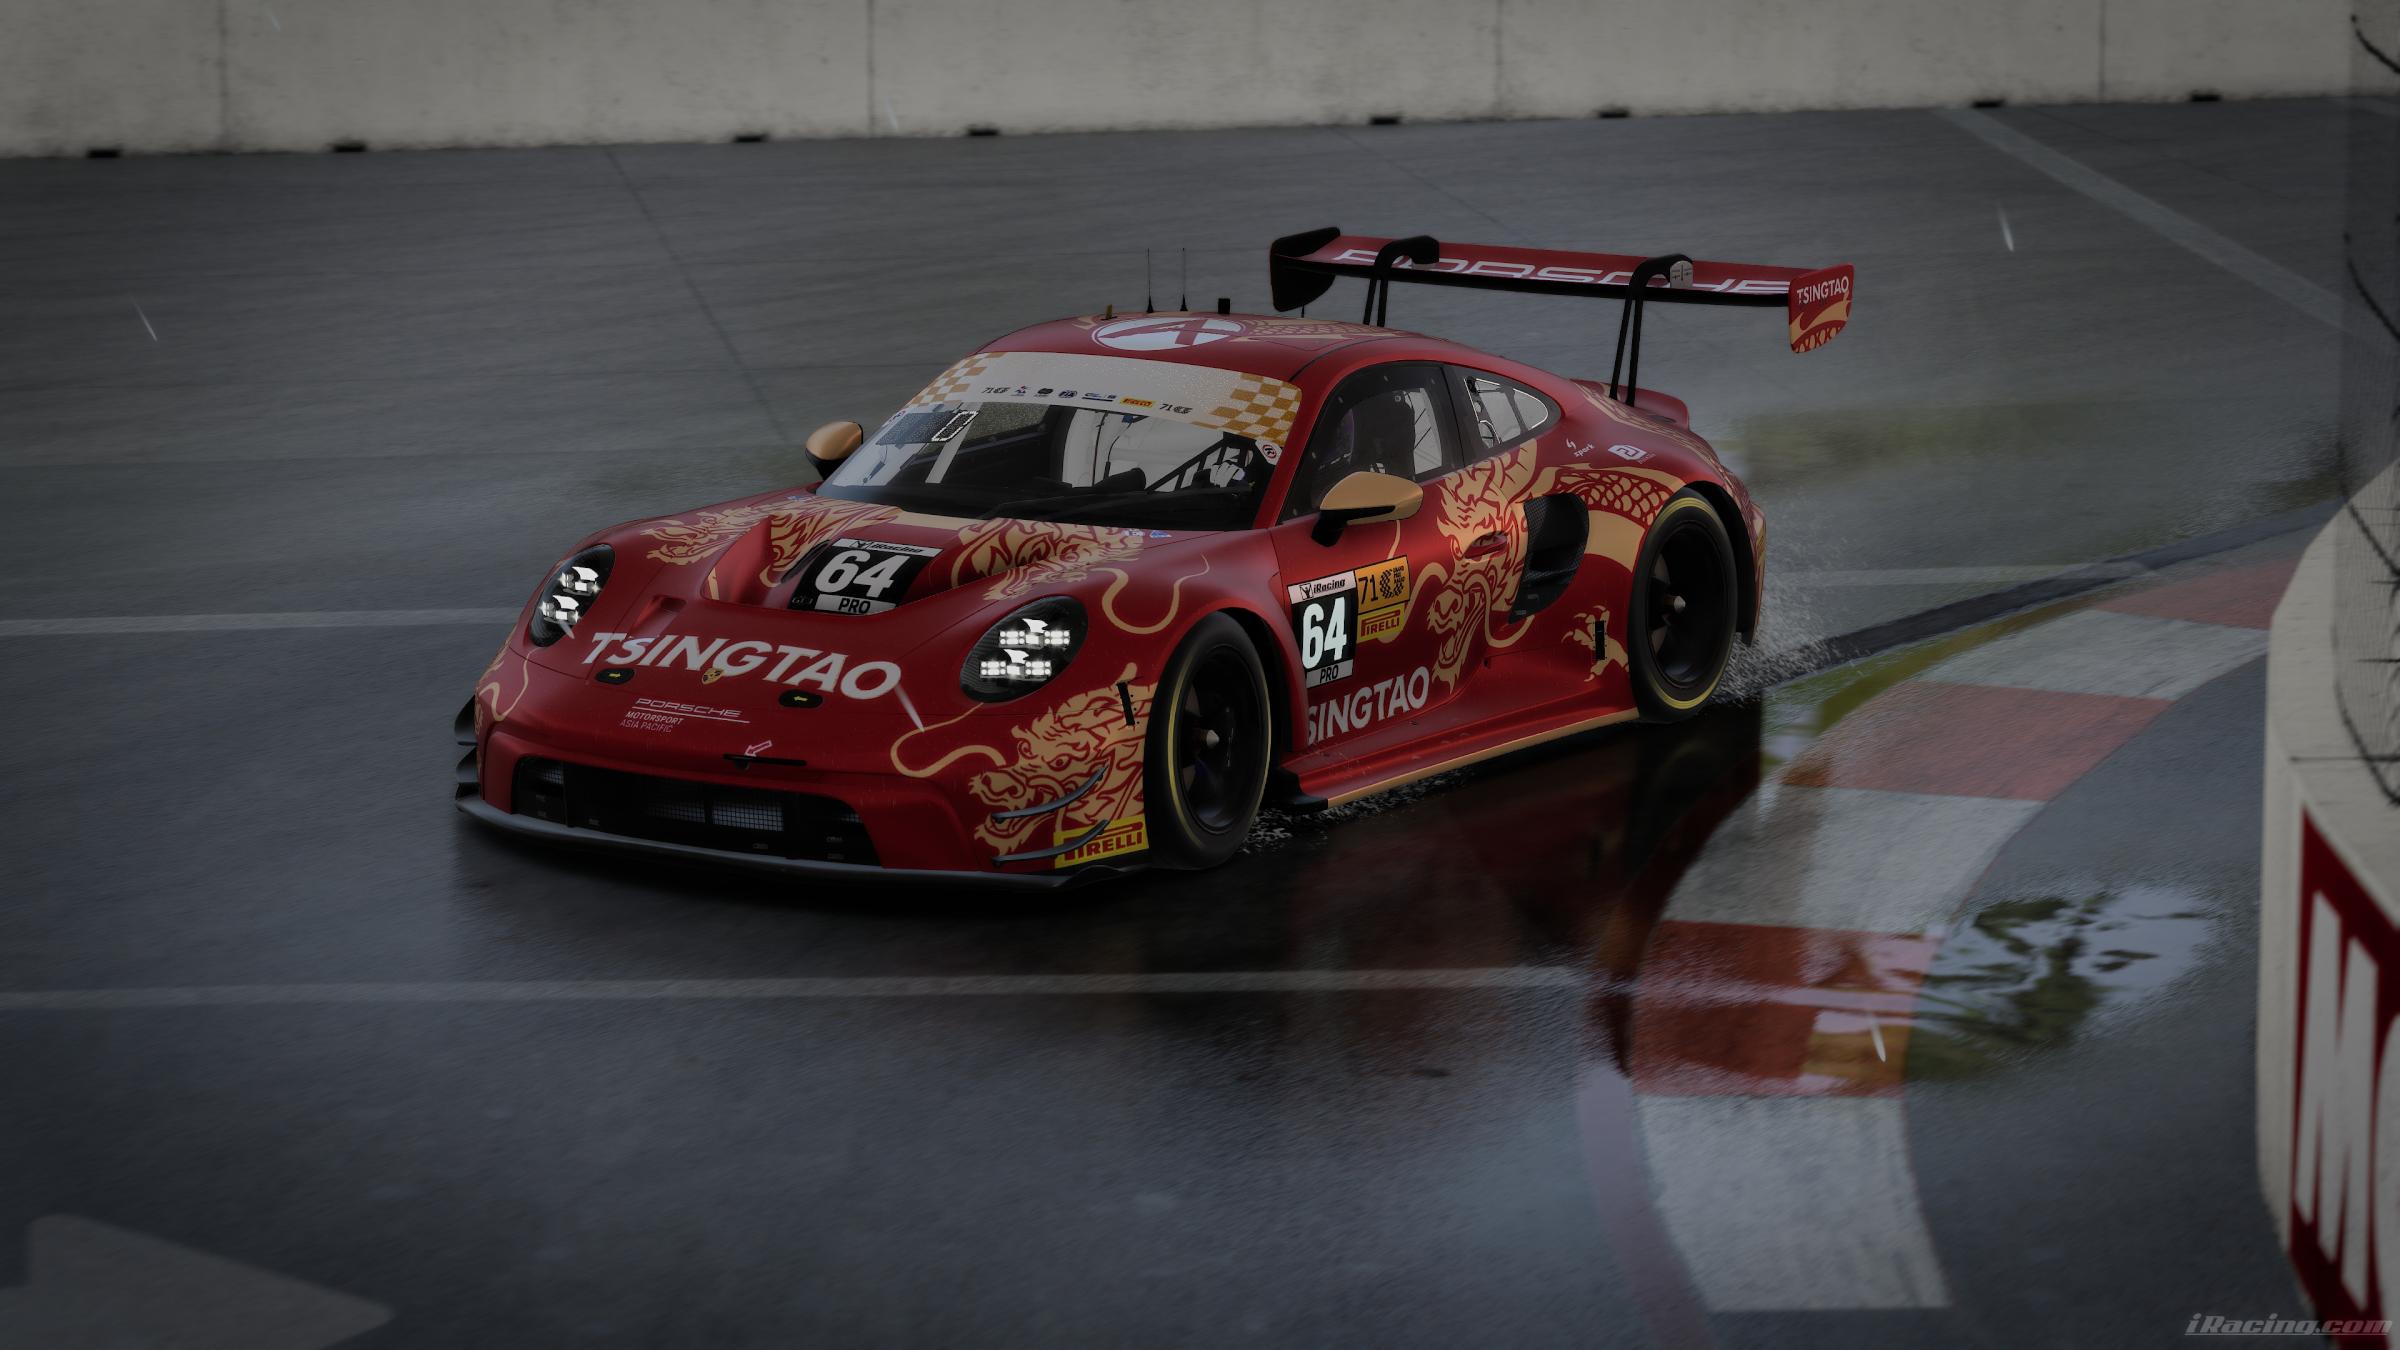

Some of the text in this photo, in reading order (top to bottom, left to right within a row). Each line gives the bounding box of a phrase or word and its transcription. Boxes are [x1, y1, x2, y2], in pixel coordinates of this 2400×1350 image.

[1796, 275, 1850, 305] TSINGTAO
[815, 549, 911, 598] 64
[1313, 578, 1346, 594] iRacing
[1358, 574, 1379, 604] 71
[838, 598, 871, 614] PRO
[1302, 596, 1348, 670] 64
[1361, 609, 1400, 636] PIRELLI
[582, 632, 902, 700] TSINGTAO
[1320, 665, 1339, 683] PRO
[625, 711, 685, 725] MOTORSPORT
[635, 698, 743, 718] PORSCHE
[1308, 665, 1430, 746] SINGTAO
[620, 719, 674, 733] ASIA PACIFIC
[1063, 822, 1143, 860] PIRELLI
[2293, 888, 2400, 1350] M
